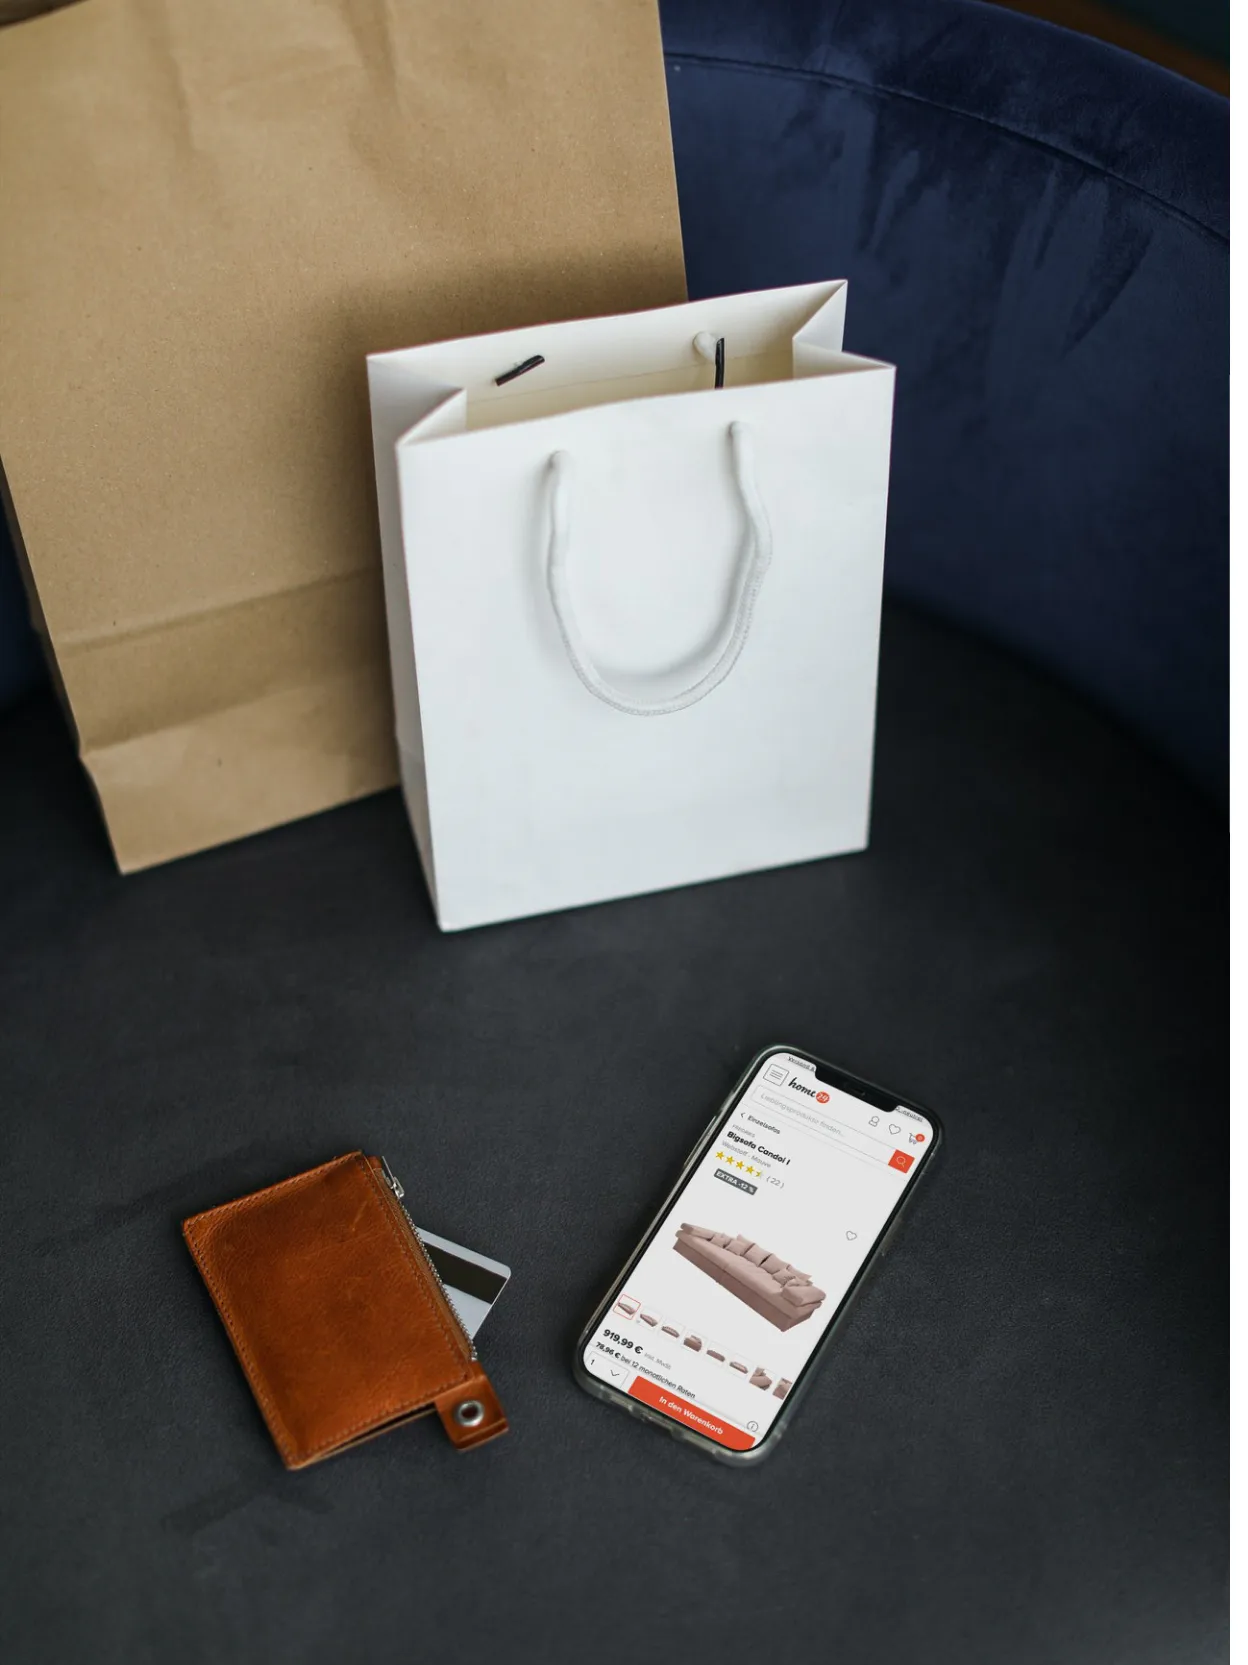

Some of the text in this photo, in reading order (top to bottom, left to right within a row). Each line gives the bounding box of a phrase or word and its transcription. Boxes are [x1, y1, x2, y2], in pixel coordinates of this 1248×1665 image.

[747, 1115, 781, 1134] Einzelsofas
[727, 1131, 757, 1149] Bigsofa
[751, 1155, 772, 1168] Mauve
[716, 1171, 738, 1185] EXTRA
[603, 1329, 634, 1349] 919,99
[634, 1345, 644, 1354] €
[596, 1341, 615, 1355] 78,96
[621, 1354, 631, 1364] bei
[631, 1360, 640, 1369] 12
[639, 1366, 677, 1389] monatlichen
[677, 1384, 696, 1399] Raten
[659, 1396, 724, 1435] In den Warenkorb
